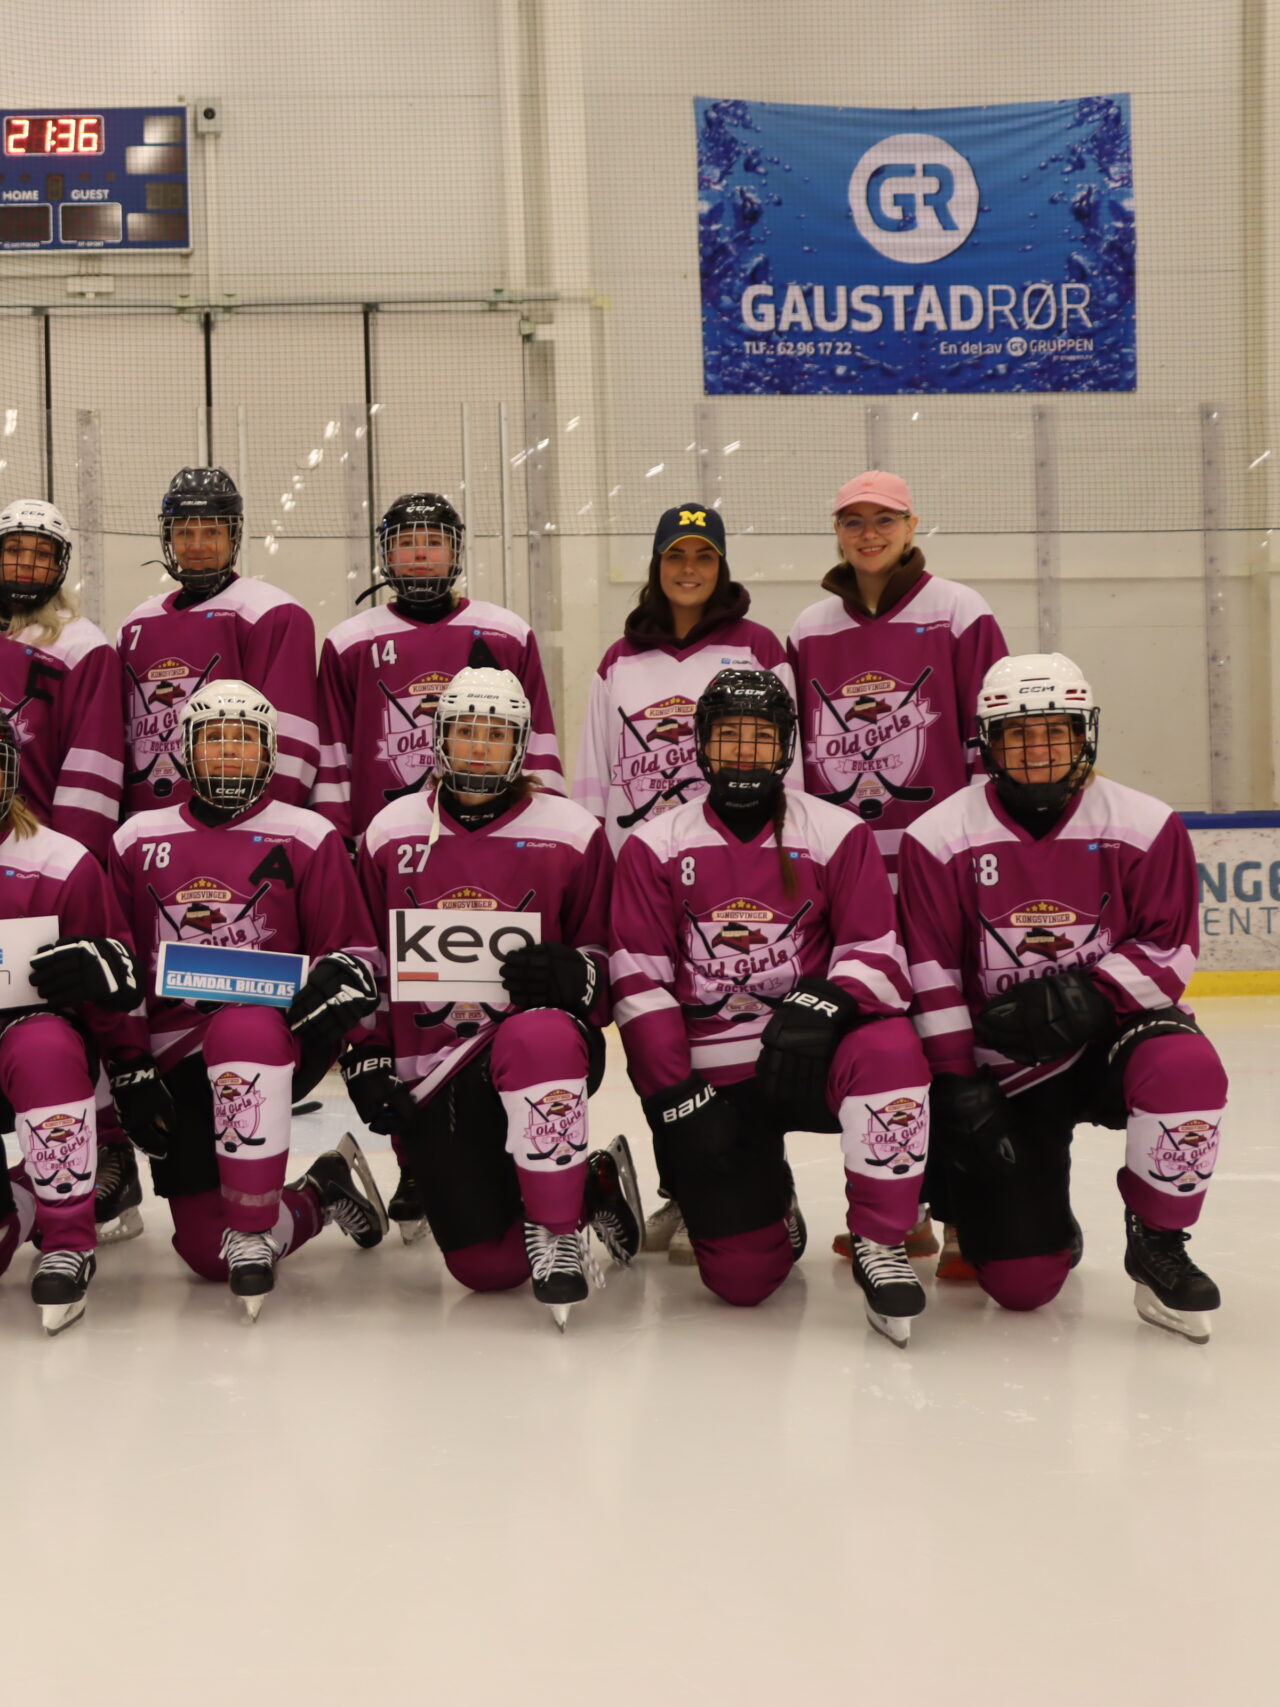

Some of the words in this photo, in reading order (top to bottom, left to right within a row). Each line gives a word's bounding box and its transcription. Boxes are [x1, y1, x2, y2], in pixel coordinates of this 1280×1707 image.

[7, 119, 99, 154] 21:36
[2, 190, 39, 201] HOME
[71, 189, 109, 200] GUEST
[866, 163, 960, 233] GR
[741, 283, 1093, 332] GAUSTADRØR
[777, 341, 794, 355] 62
[797, 341, 815, 355] 96
[818, 341, 833, 355] 17
[835, 341, 852, 355] 22
[940, 341, 957, 355] En
[960, 341, 982, 355] del
[984, 343, 1002, 354] av
[1029, 339, 1094, 352] GRUPPEN
[405, 504, 435, 513] CCM
[679, 510, 707, 527] M
[129, 624, 142, 651] 7
[371, 639, 397, 668] 14
[412, 683, 450, 693] KONGSVIN
[734, 688, 766, 697] CCM
[846, 681, 891, 695] KONGSVINGER
[1019, 685, 1055, 694] CCM
[136, 714, 161, 737] Old
[397, 732, 429, 753] Old
[826, 734, 861, 758] Old
[865, 713, 911, 747] Girls
[631, 754, 662, 777] Old
[666, 746, 696, 769] Gir
[851, 757, 890, 771] HOCKEY
[215, 787, 246, 795] CCM
[728, 781, 761, 789] CCM
[141, 842, 172, 871] 78
[397, 843, 431, 874] 27
[249, 844, 294, 889] A
[681, 856, 696, 886] 8
[180, 890, 228, 901] KONGSVINGER
[442, 899, 493, 910] KONGSVINGER
[716, 910, 768, 921] KONGSVINGER
[1015, 912, 1070, 924] KONGSVINGER
[1203, 906, 1279, 936] ENT
[734, 947, 789, 978] Girls
[235, 979, 275, 995] BILCO
[276, 983, 295, 997] AS
[663, 1083, 717, 1124] BAUE
[536, 1121, 557, 1136] Old
[875, 1131, 897, 1145] Old
[36, 1148, 58, 1162] Old
[60, 1136, 86, 1157] Girls
[1162, 1150, 1186, 1163] Old
